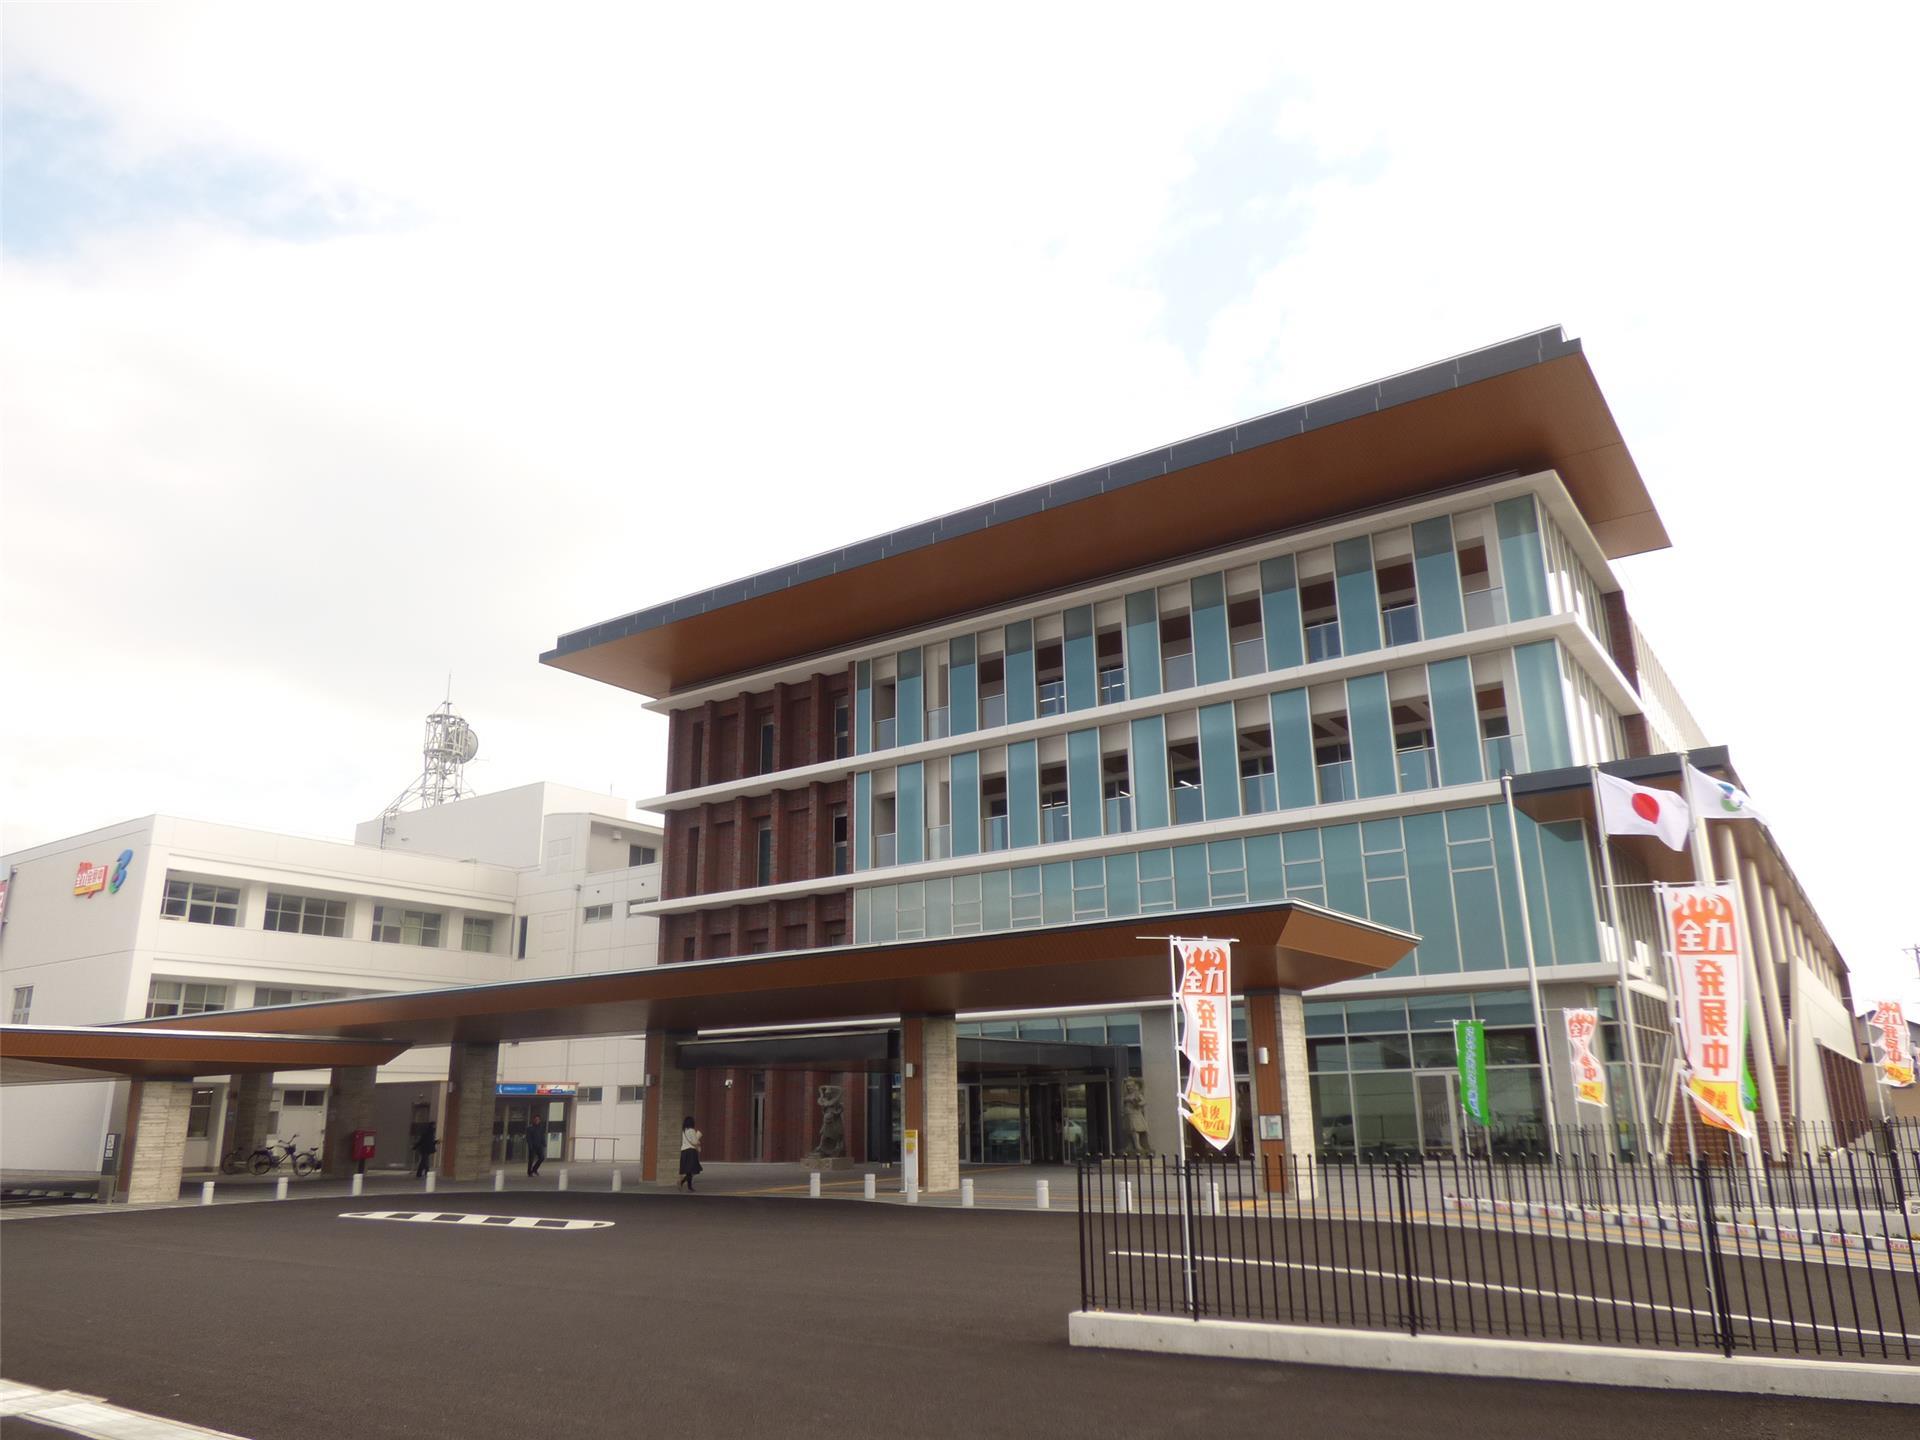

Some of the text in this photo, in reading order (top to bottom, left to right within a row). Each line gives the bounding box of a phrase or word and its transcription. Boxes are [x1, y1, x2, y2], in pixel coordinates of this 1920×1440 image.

[1678, 918, 1734, 952] 全力
[1184, 966, 1225, 993] 全力
[1197, 999, 1220, 1094] 発展中
[1696, 959, 1730, 1077] 発展中
